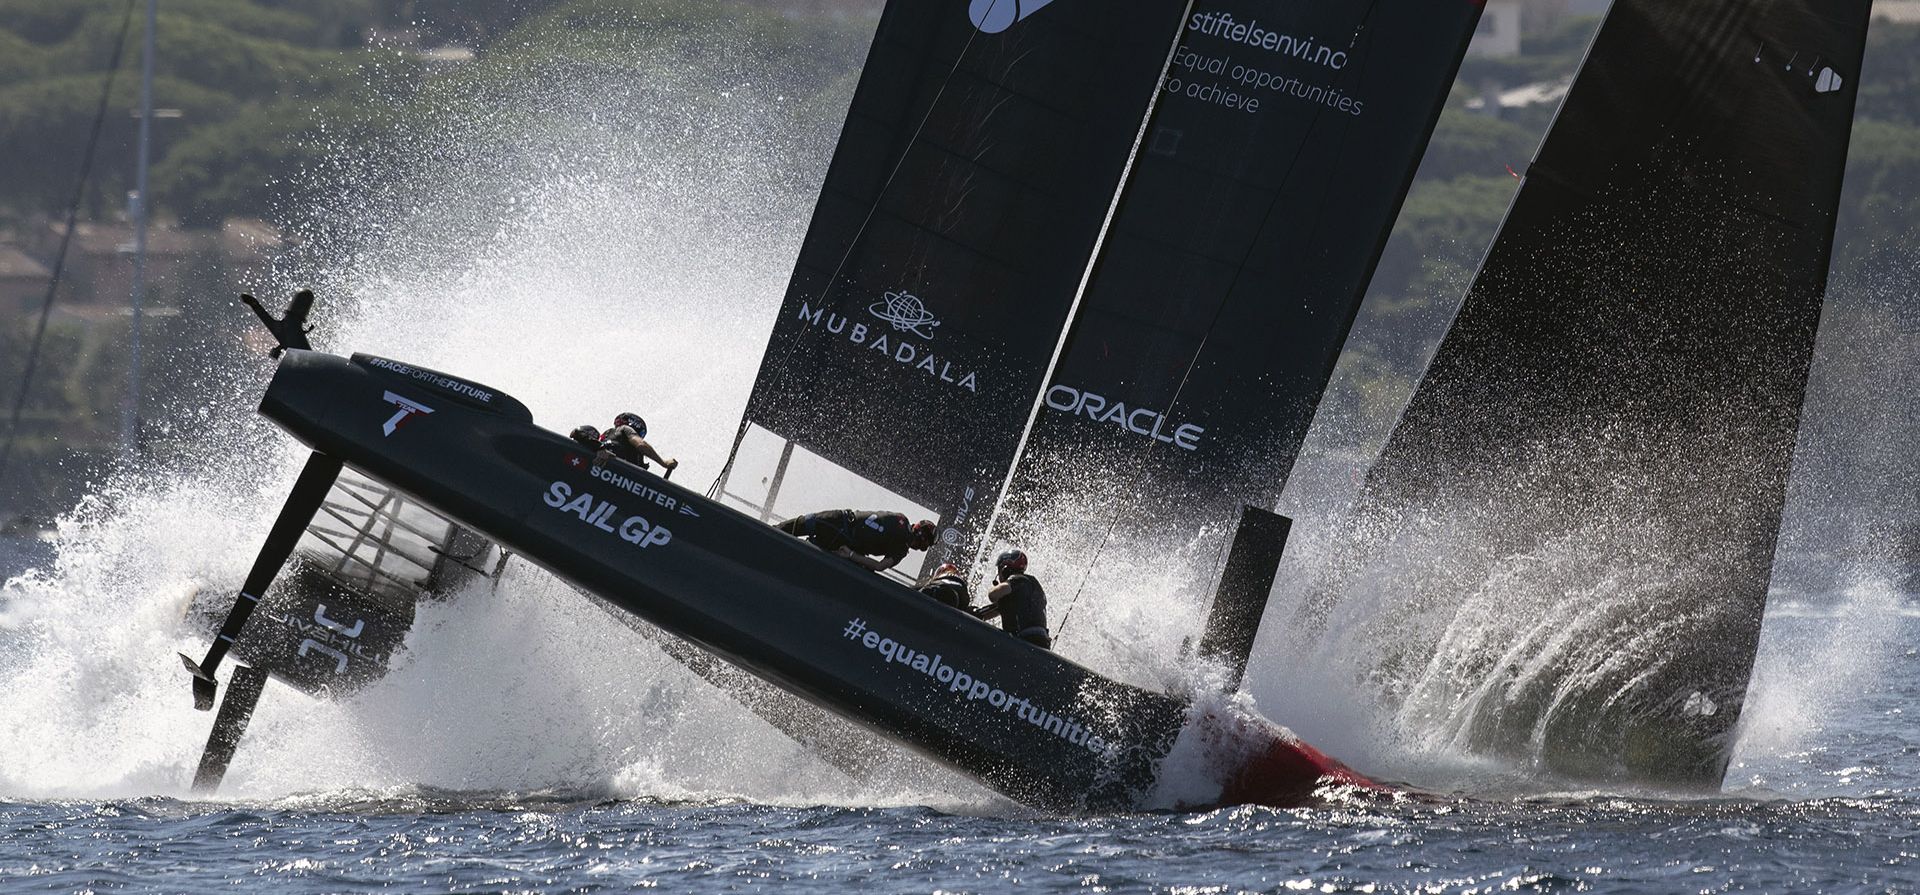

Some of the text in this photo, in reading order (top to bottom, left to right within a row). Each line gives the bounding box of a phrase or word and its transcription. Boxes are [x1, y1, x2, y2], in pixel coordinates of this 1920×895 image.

[1162, 74, 1260, 113] to achieve
[1172, 45, 1364, 116] Equal opportunities
[798, 302, 977, 393] MUBADALA
[369, 357, 493, 403] #RACEFORTHEFUTURE
[1045, 384, 1205, 451] ORACLE
[590, 465, 677, 511] SCHNEITER
